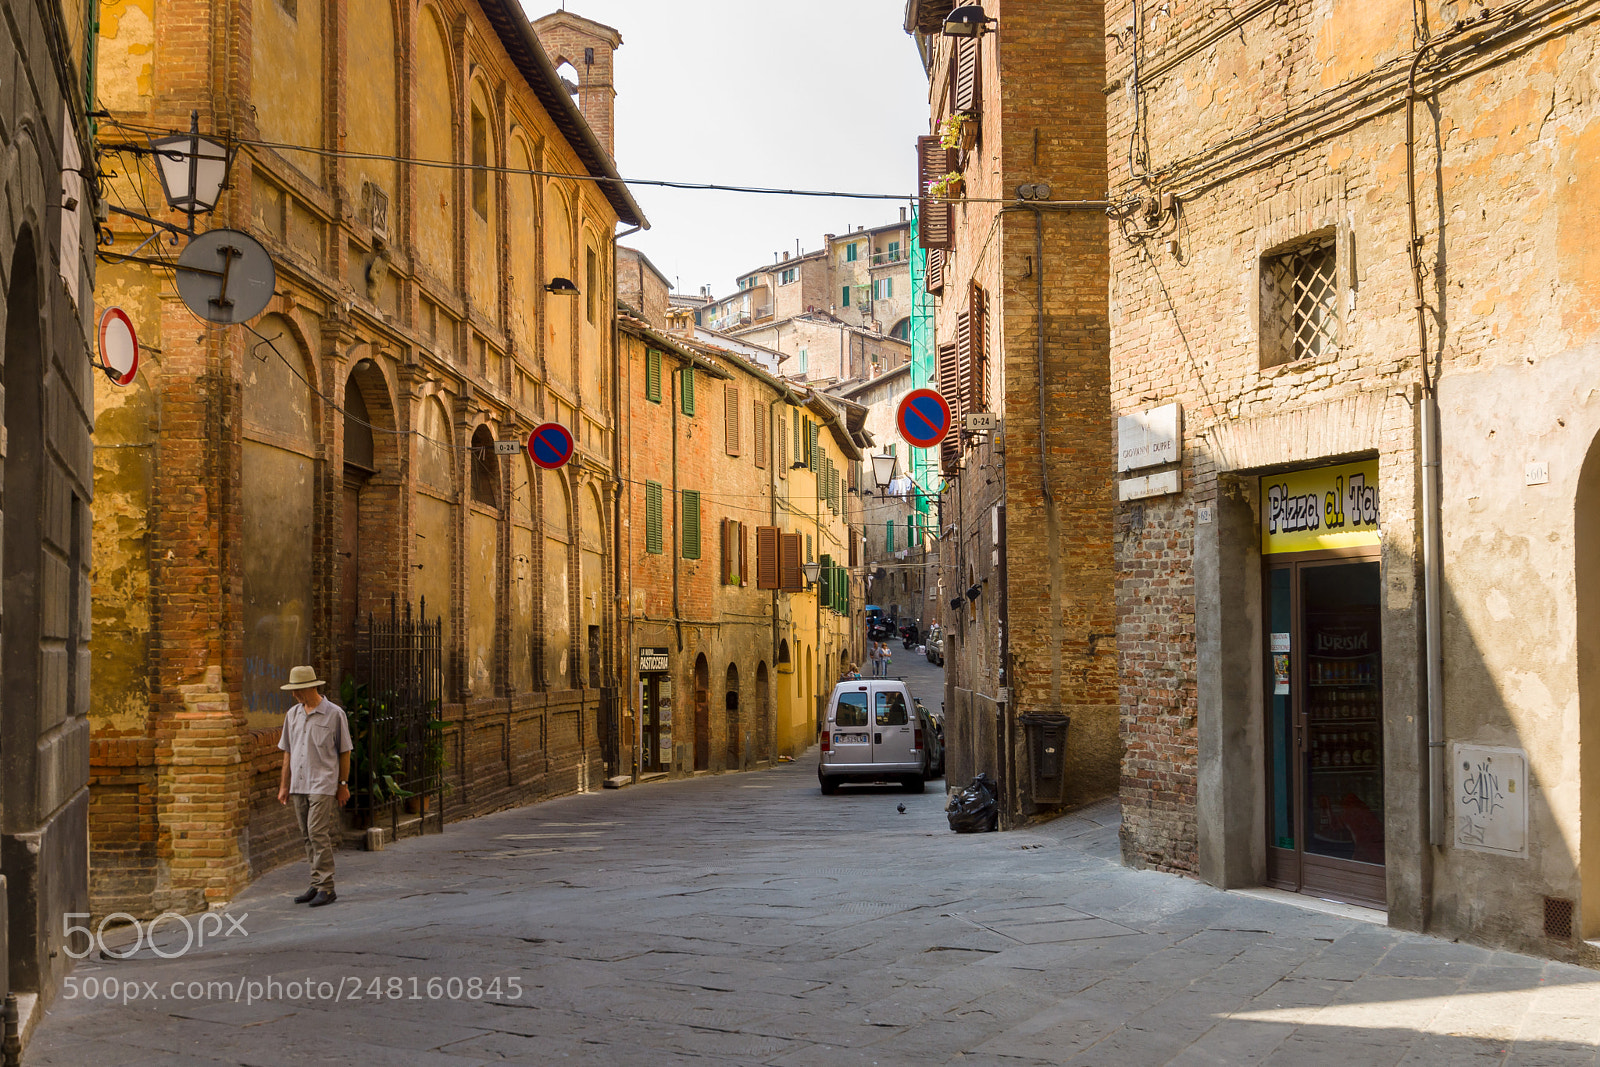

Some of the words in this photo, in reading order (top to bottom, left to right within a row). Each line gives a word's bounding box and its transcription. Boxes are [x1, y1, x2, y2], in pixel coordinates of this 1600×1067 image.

[972, 417, 989, 426] 0-24
[1122, 445, 1150, 459] GIOVANNI
[1530, 466, 1543, 481] 60
[1268, 483, 1319, 535] Pizza
[1324, 475, 1344, 529] al
[1200, 510, 1208, 521] 62
[1317, 631, 1369, 650] LURISIA
[640, 656, 668, 670] PASTICCERIA
